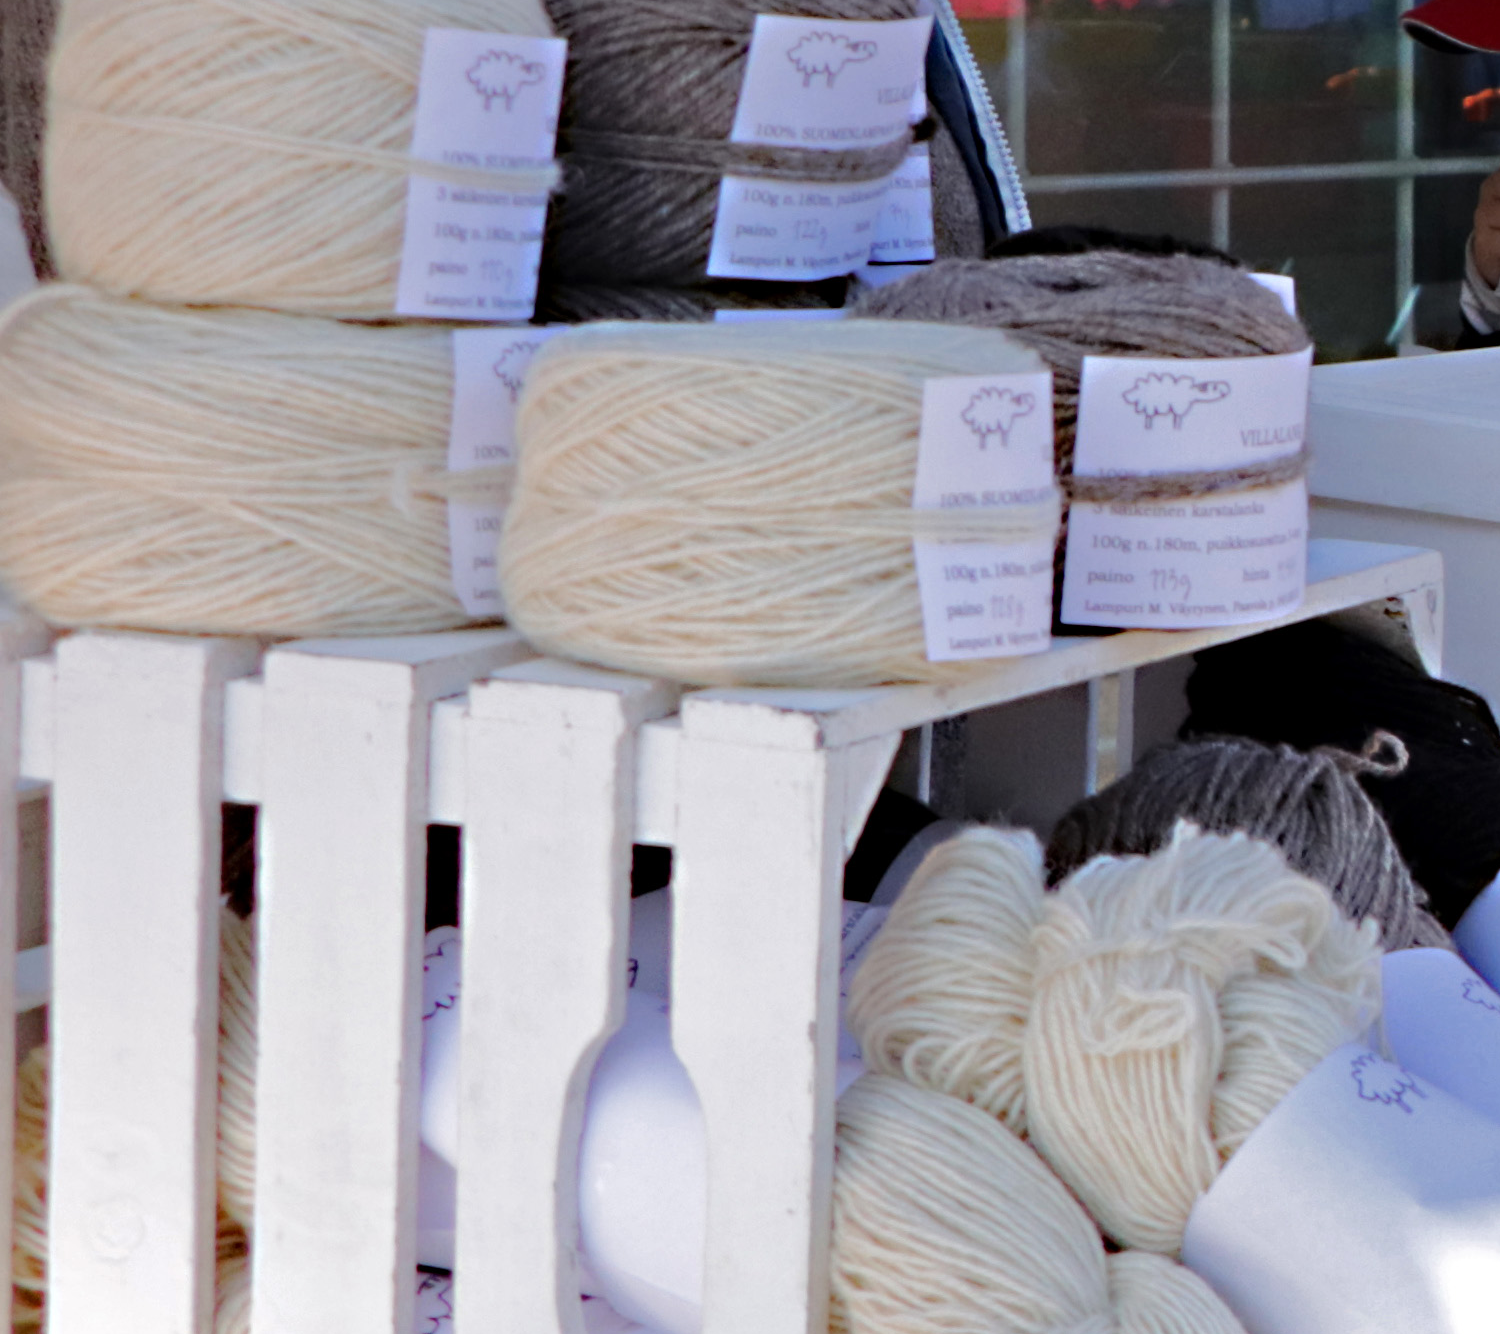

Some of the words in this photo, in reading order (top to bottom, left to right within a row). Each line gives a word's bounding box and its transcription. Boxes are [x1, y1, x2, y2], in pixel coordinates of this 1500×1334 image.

[735, 223, 777, 239] paino
[474, 518, 500, 533] 100
[1091, 534, 1132, 553] 100g
[1087, 570, 1135, 585] paino
[946, 604, 985, 620] paino
[1084, 599, 1144, 616] Lampuri
